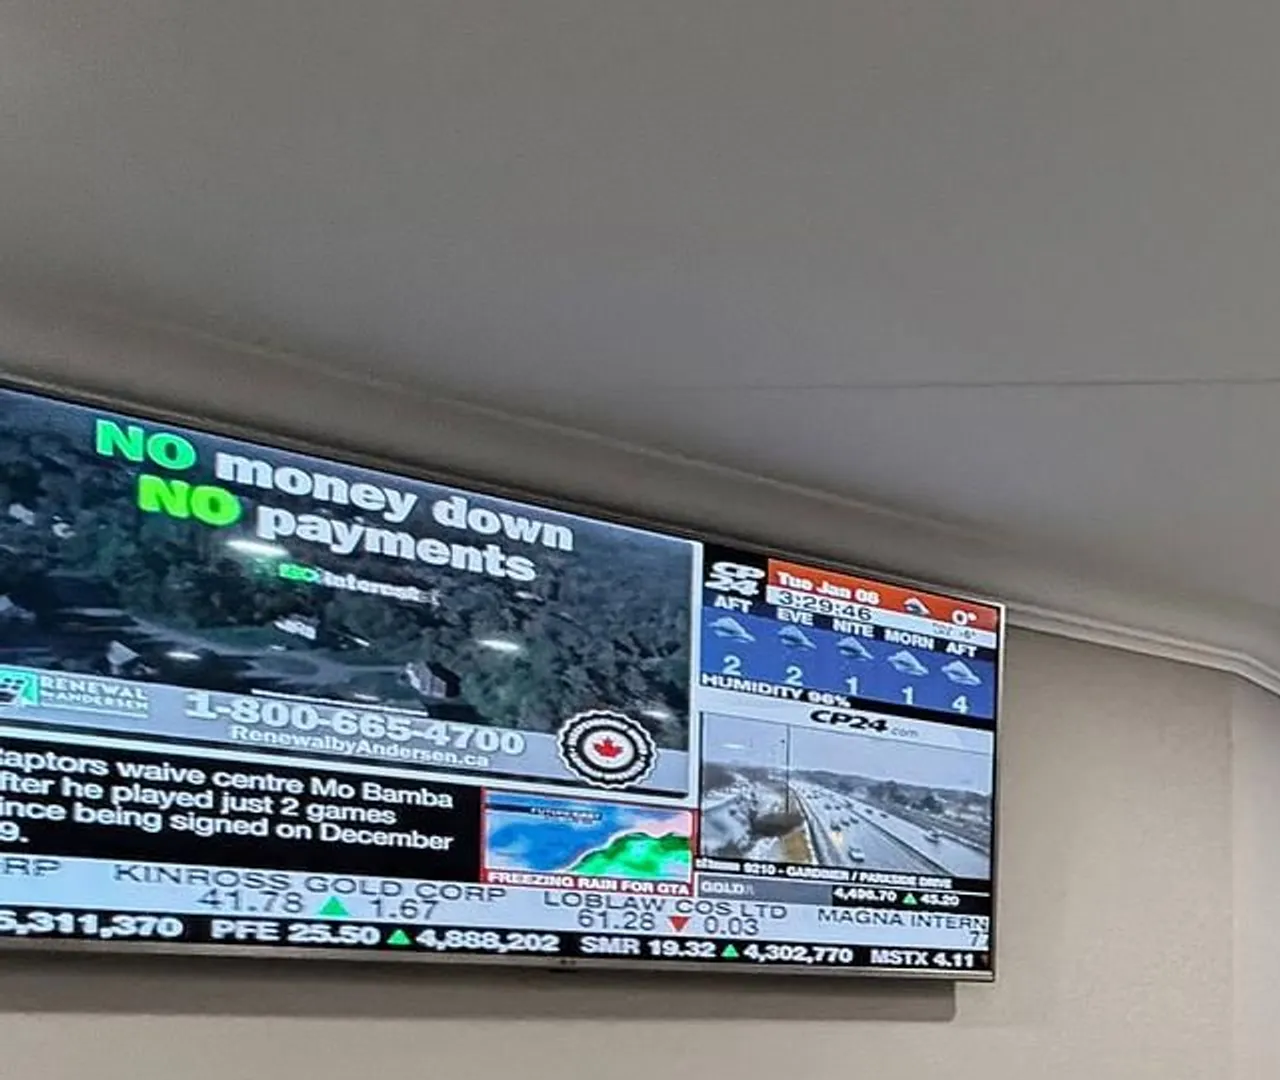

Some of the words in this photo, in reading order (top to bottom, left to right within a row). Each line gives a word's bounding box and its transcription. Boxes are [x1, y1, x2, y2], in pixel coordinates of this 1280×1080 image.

[95, 419, 197, 470] NO
[213, 452, 418, 523] money
[432, 496, 574, 552] down
[138, 475, 242, 526] NO
[257, 504, 537, 582] payments
[705, 573, 759, 596] 24
[712, 562, 765, 579] CP
[777, 571, 813, 591] Tue
[816, 581, 852, 599] Jan
[777, 590, 872, 621] 3:29:46
[713, 594, 753, 613] AFT
[777, 606, 814, 627] EVE
[832, 618, 875, 638] NITE
[884, 628, 936, 651] MORN
[946, 641, 978, 658] AFT
[40, 676, 148, 700] RENEWAL
[701, 672, 802, 700] HUMIDITY
[723, 655, 743, 676] 2
[784, 665, 804, 687] 2
[845, 676, 859, 697] 1
[901, 686, 914, 706] 1
[952, 695, 970, 716] 4
[184, 689, 525, 757] 1-800-665-4700
[809, 709, 889, 733] CP24
[0, 748, 109, 777] aptors
[115, 761, 206, 787] waive
[212, 769, 305, 797] centre
[310, 776, 356, 801] Mo
[362, 782, 454, 810] Bamba
[60, 774, 104, 801] he
[110, 782, 214, 814] played
[219, 792, 274, 816] just
[279, 797, 300, 817] 2
[305, 804, 398, 826] games
[72, 801, 163, 833] being
[169, 811, 269, 838] signed
[275, 824, 312, 841] on
[320, 823, 455, 852] December
[113, 863, 290, 891] KINROSS
[303, 875, 402, 898] GOLD
[414, 882, 507, 902] CORP
[487, 871, 574, 889] FREEZING
[577, 879, 617, 891] RAIN
[620, 883, 654, 894] FOR
[656, 884, 690, 896] GTA
[197, 887, 305, 915] 41.78
[370, 896, 439, 921] 1.67
[543, 890, 666, 912] LOBLAW
[674, 899, 732, 916] COS
[739, 903, 788, 919] LTD
[817, 908, 905, 925] MAGNA
[577, 908, 656, 931] 61.28
[703, 914, 760, 936] 0.03
[210, 918, 281, 942] PFE
[287, 923, 381, 944] 25.50
[415, 929, 561, 953] 4,888,202
[579, 935, 642, 955] SMR
[648, 940, 717, 958] 19.32
[742, 942, 854, 963] 4,302,770
[870, 949, 929, 967] MSTX
[933, 952, 974, 968] 4.11
